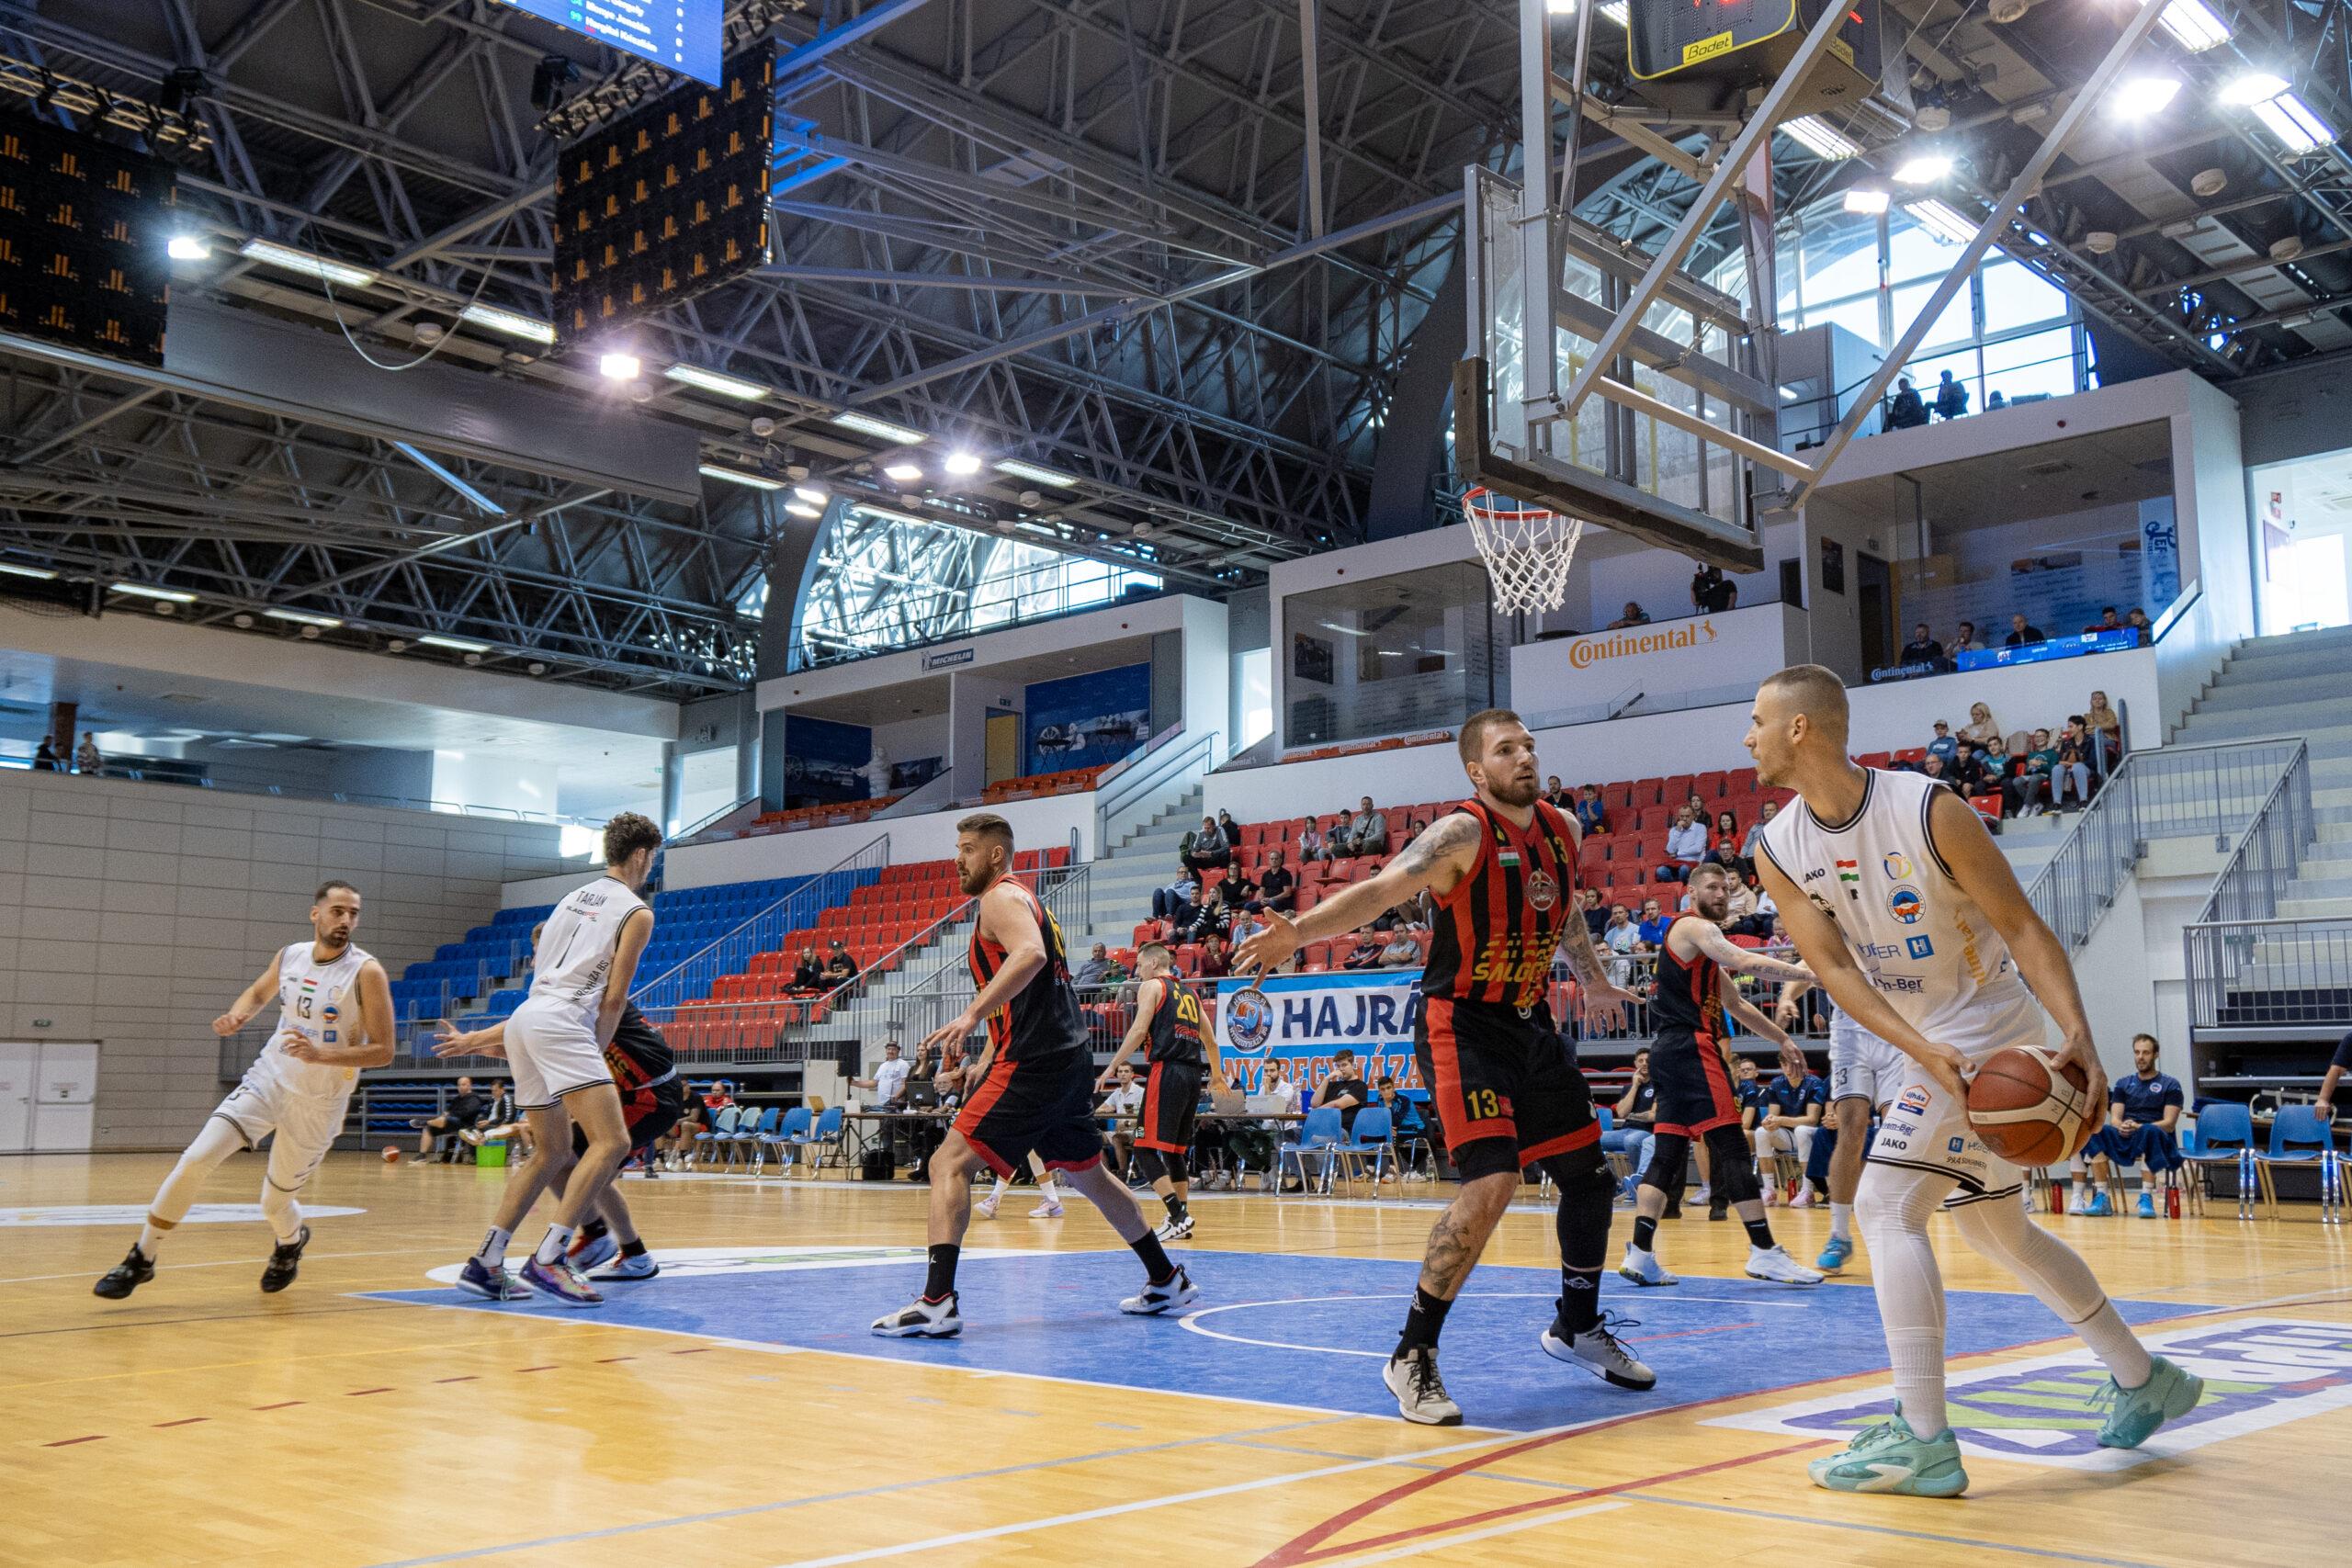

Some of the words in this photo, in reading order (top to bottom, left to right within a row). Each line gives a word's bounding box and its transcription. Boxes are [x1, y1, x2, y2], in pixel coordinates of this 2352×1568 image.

[1686, 37, 1730, 59] Bodet
[932, 650, 972, 666] MICHELIN
[1569, 624, 1697, 670] Continental
[1871, 662, 1926, 681] Continental
[1404, 731, 1443, 746] Continental
[1544, 836, 1568, 863] 13
[296, 995, 313, 1020] 13
[1172, 989, 1199, 1024] 20
[1467, 1089, 1499, 1120] 13
[1881, 1137, 1907, 1150] JAKO
